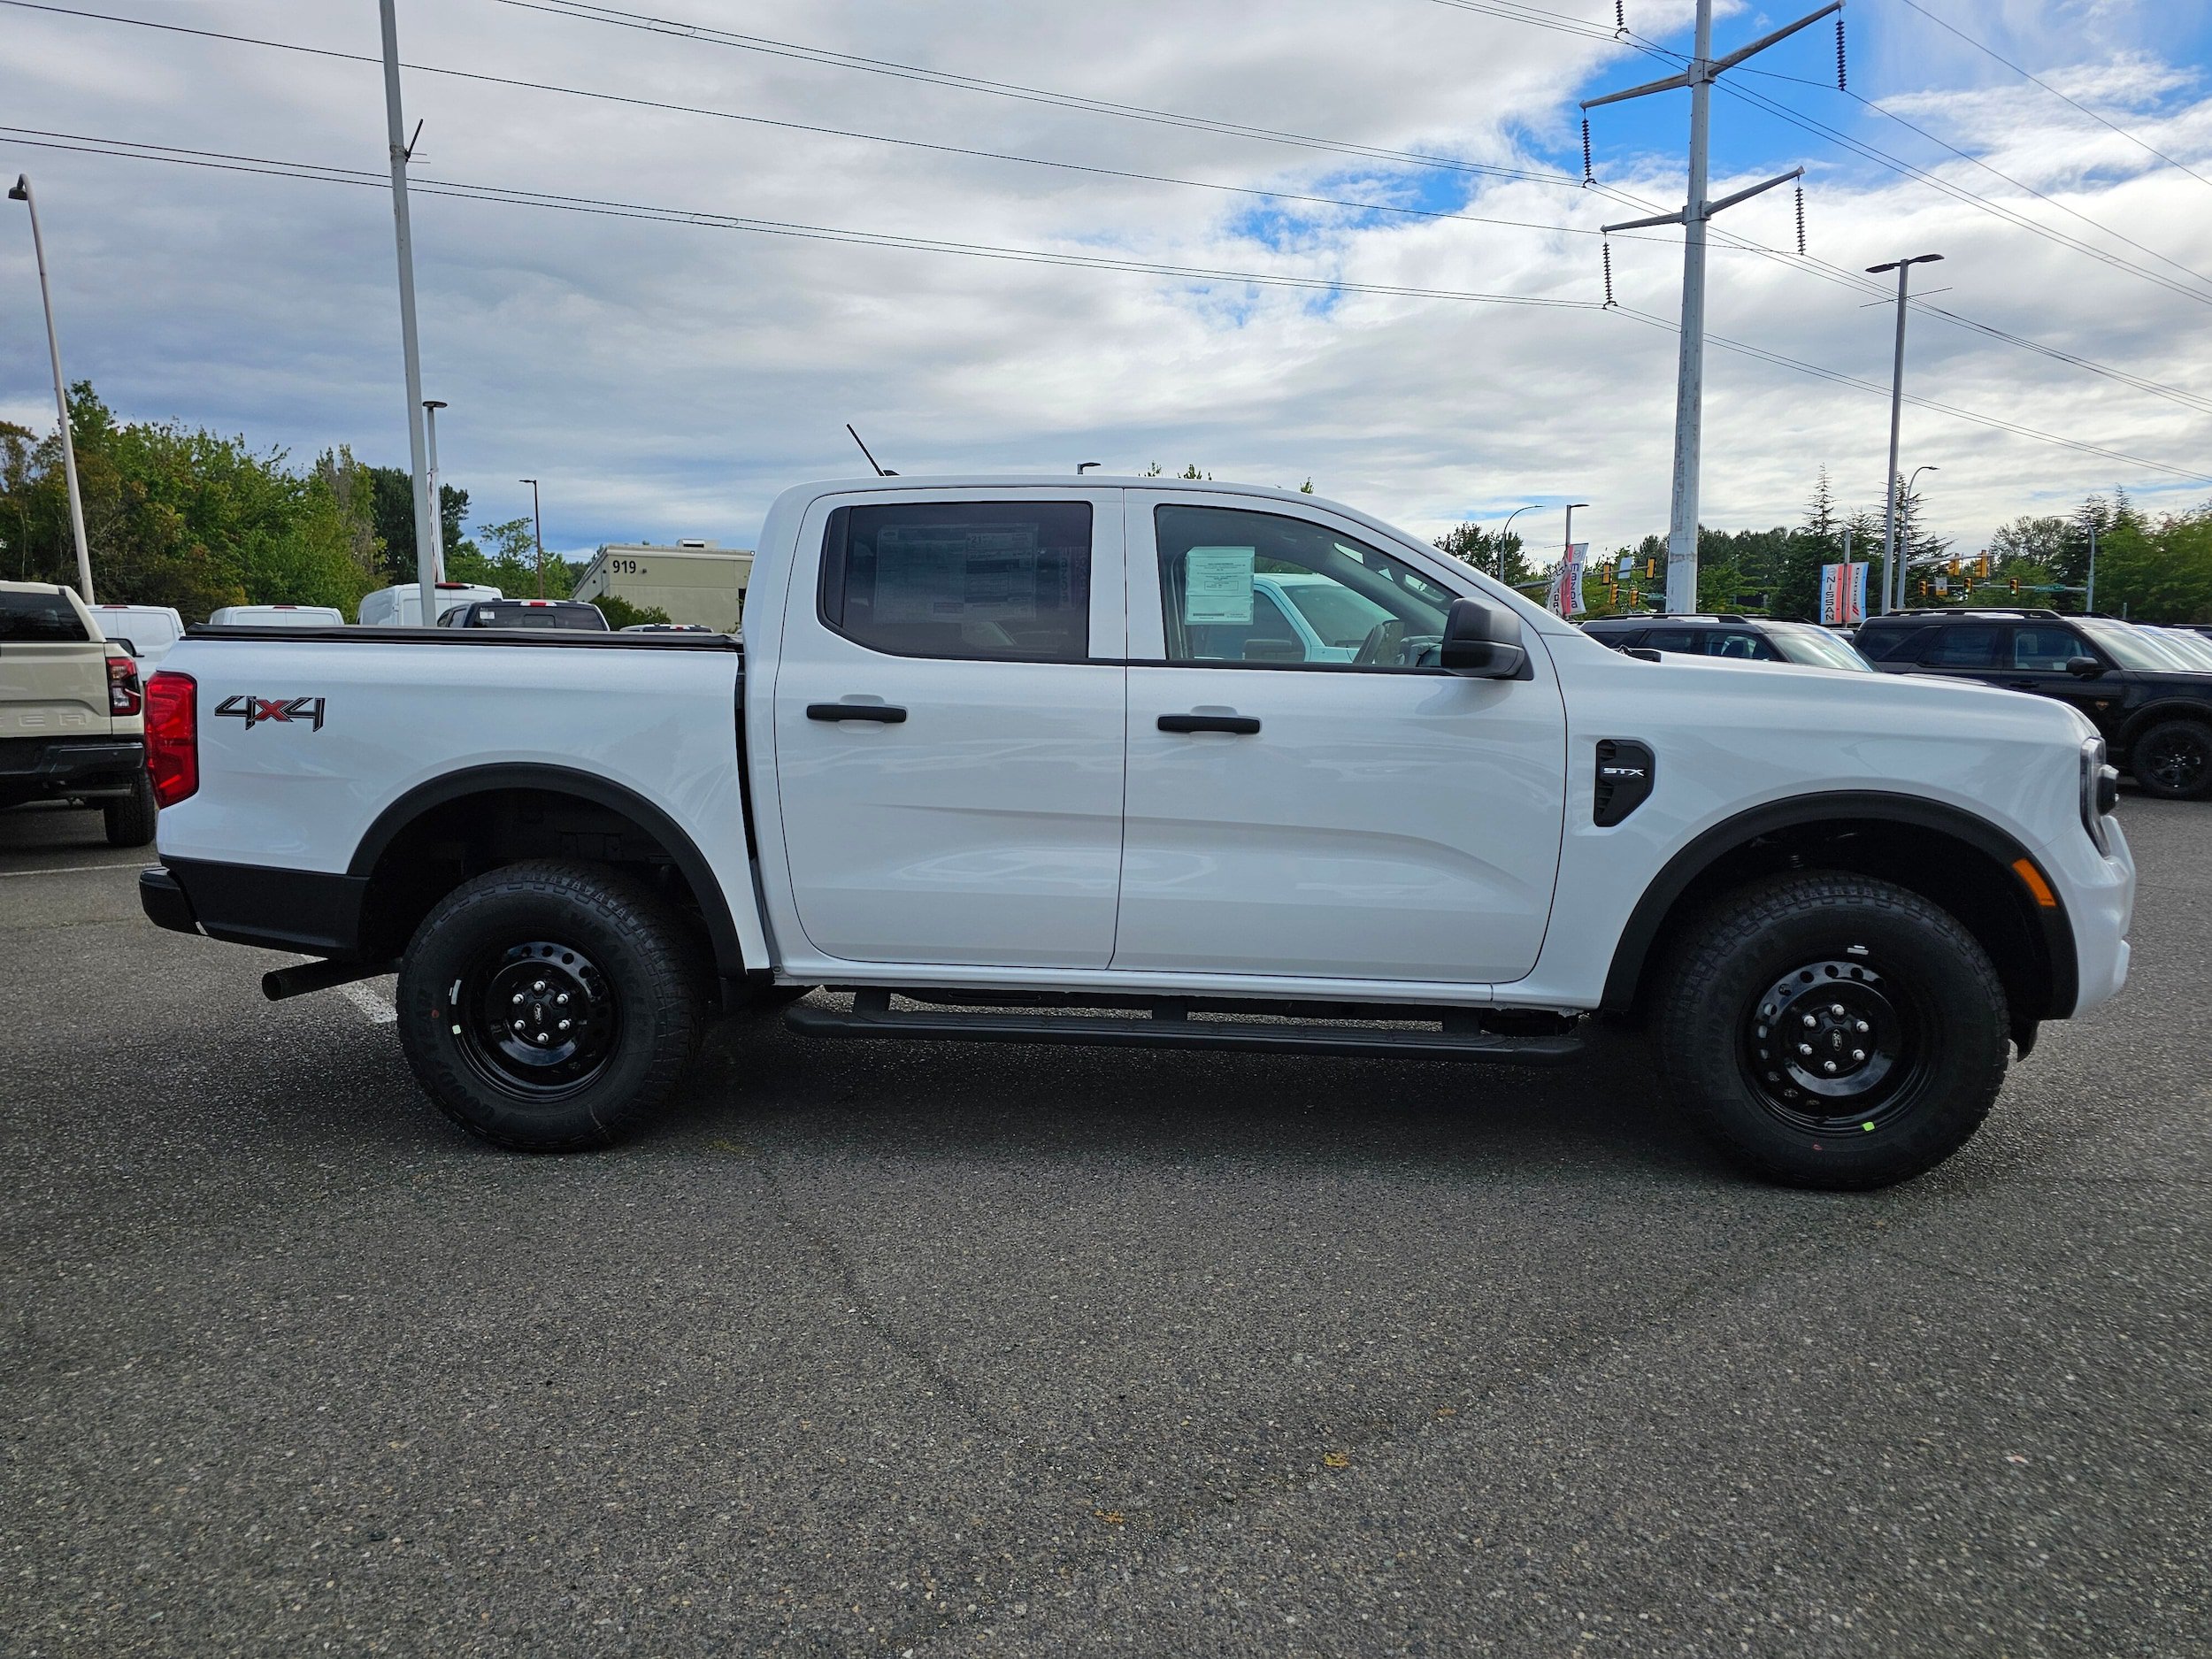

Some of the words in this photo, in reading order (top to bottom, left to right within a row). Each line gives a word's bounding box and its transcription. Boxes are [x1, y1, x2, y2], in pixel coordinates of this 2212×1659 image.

[612, 560, 636, 573] 919
[1825, 576, 1836, 621] NISSAN
[1603, 767, 1645, 777] STX
